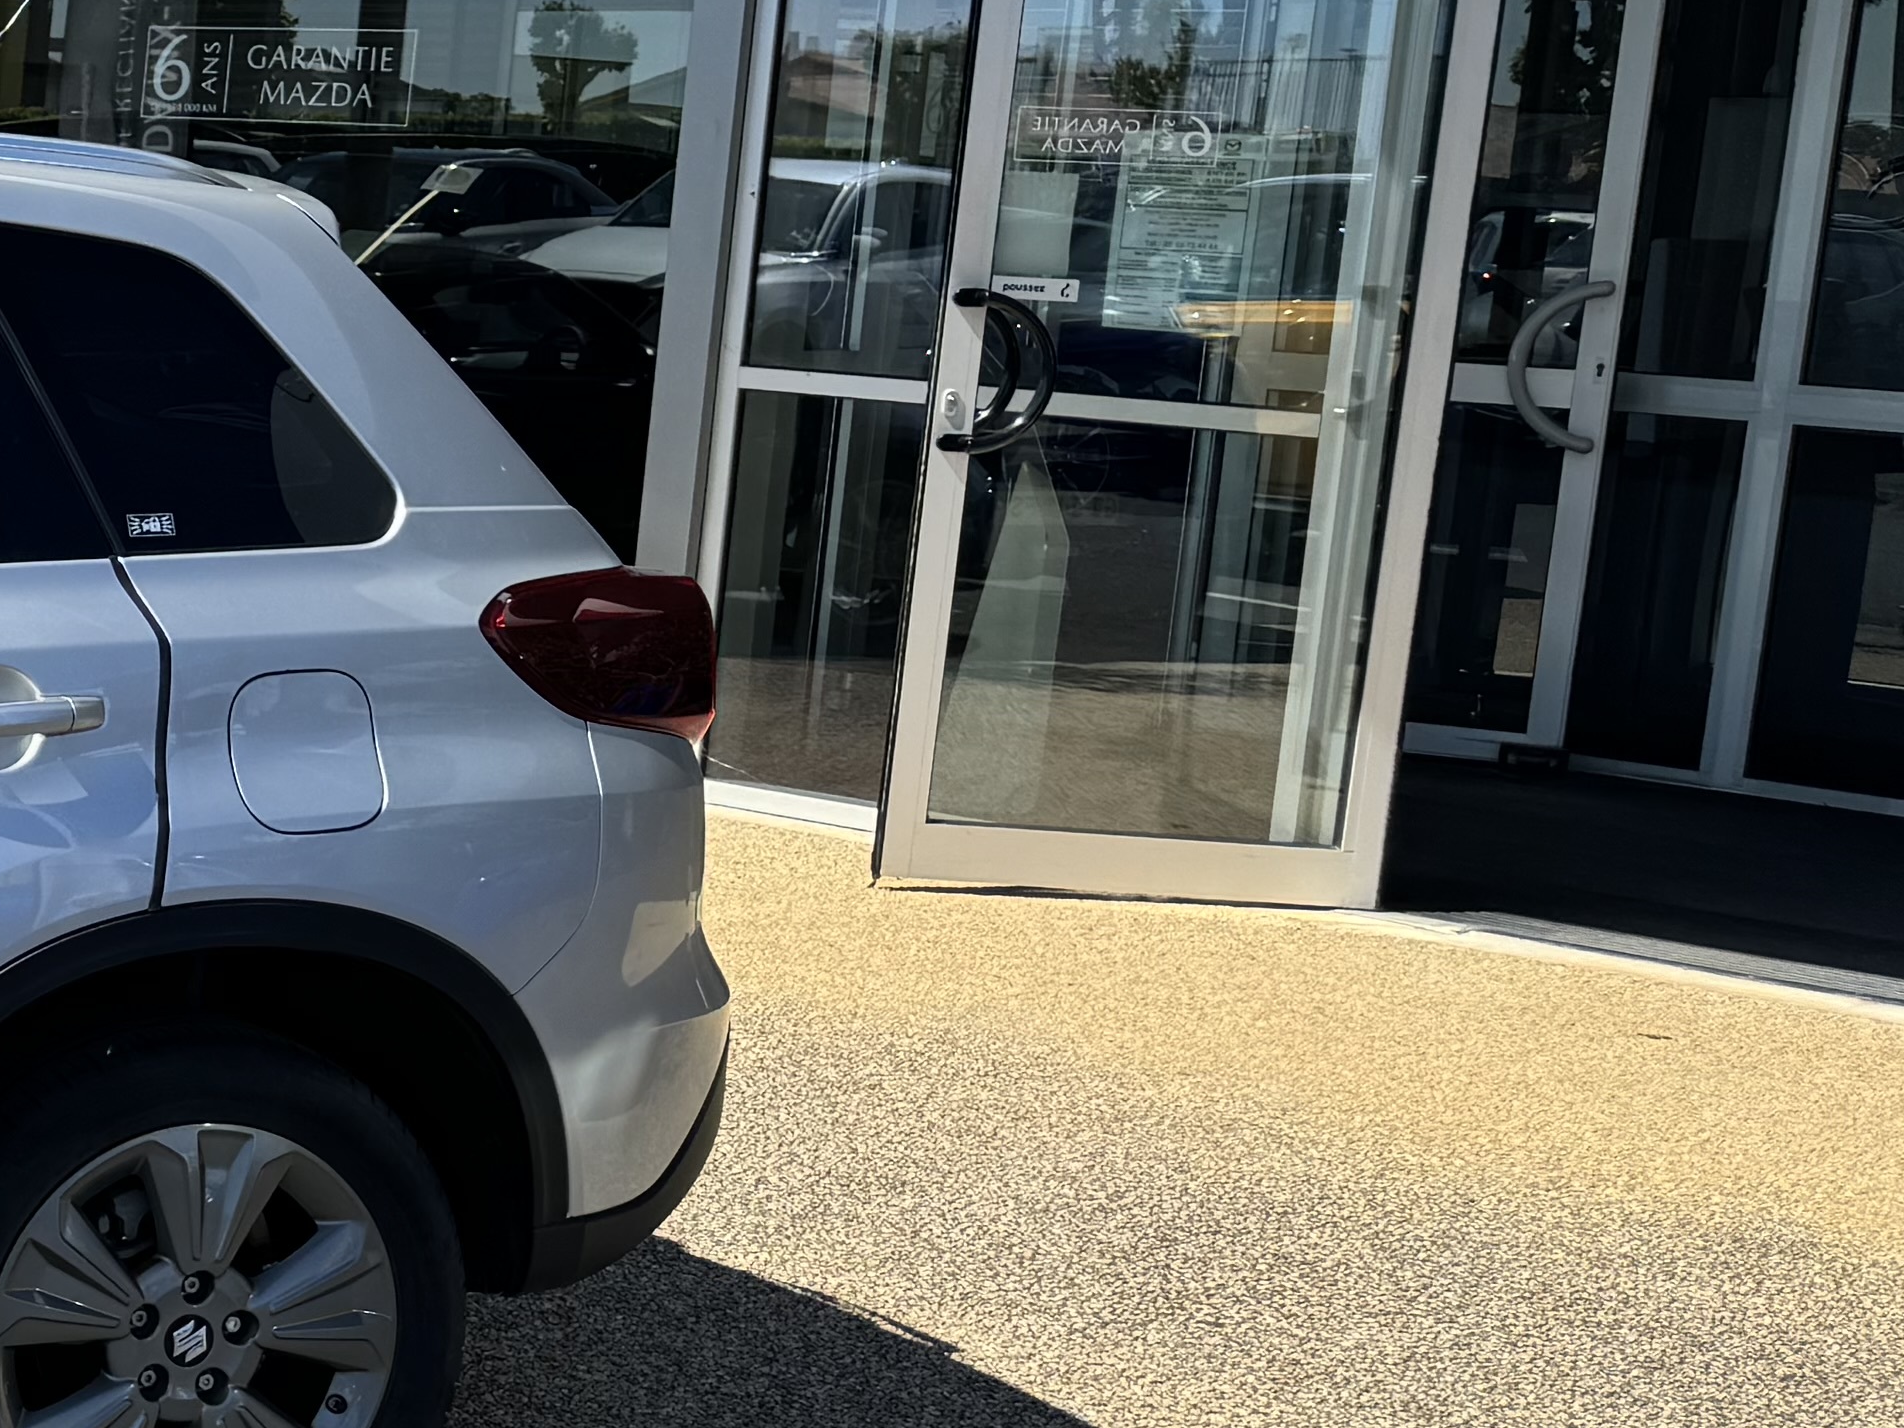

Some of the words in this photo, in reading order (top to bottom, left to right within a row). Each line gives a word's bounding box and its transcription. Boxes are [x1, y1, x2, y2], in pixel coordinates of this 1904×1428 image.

[153, 34, 191, 101] 6
[201, 41, 222, 95] ANS
[247, 44, 395, 72] GARANTIE
[259, 80, 373, 109] MAZDA
